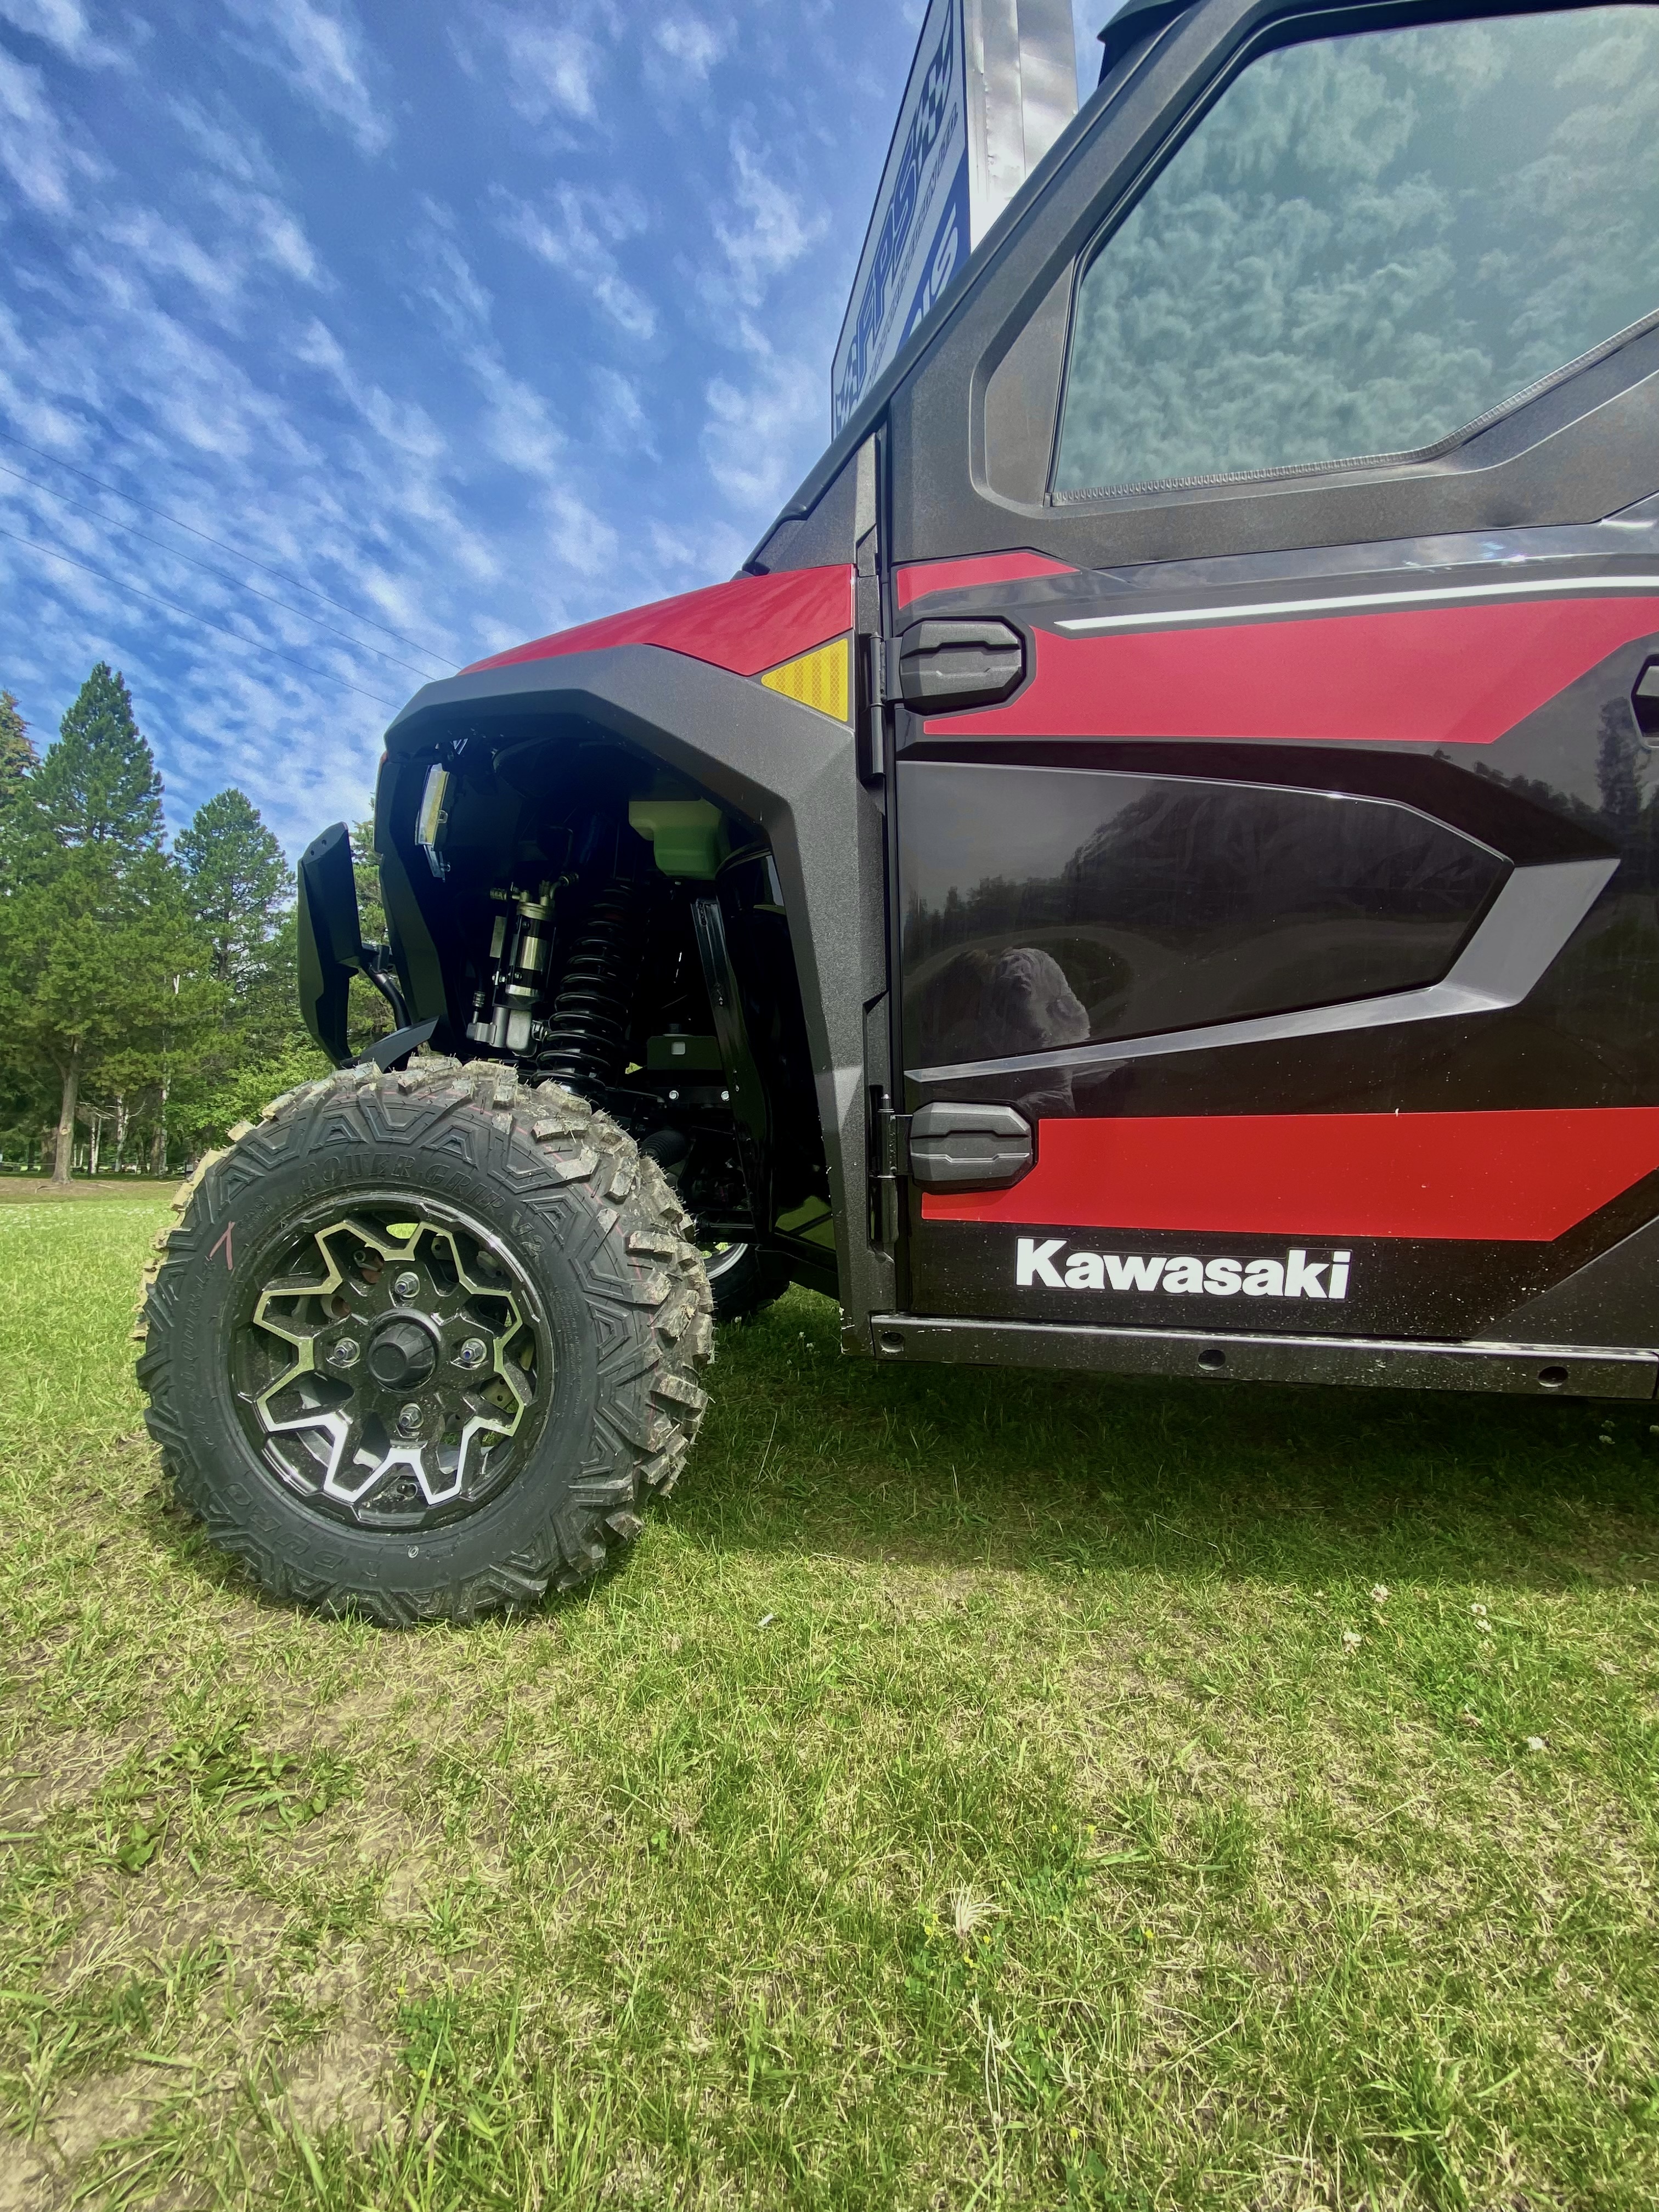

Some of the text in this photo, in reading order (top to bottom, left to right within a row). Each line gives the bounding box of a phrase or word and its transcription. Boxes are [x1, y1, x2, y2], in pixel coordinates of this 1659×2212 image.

[856, 108, 918, 386] FPS
[425, 1163, 506, 1209] GRIP
[509, 1209, 548, 1258] V2
[1015, 1238, 1351, 1299] Kawasaki
[226, 1482, 348, 1570] DURO
